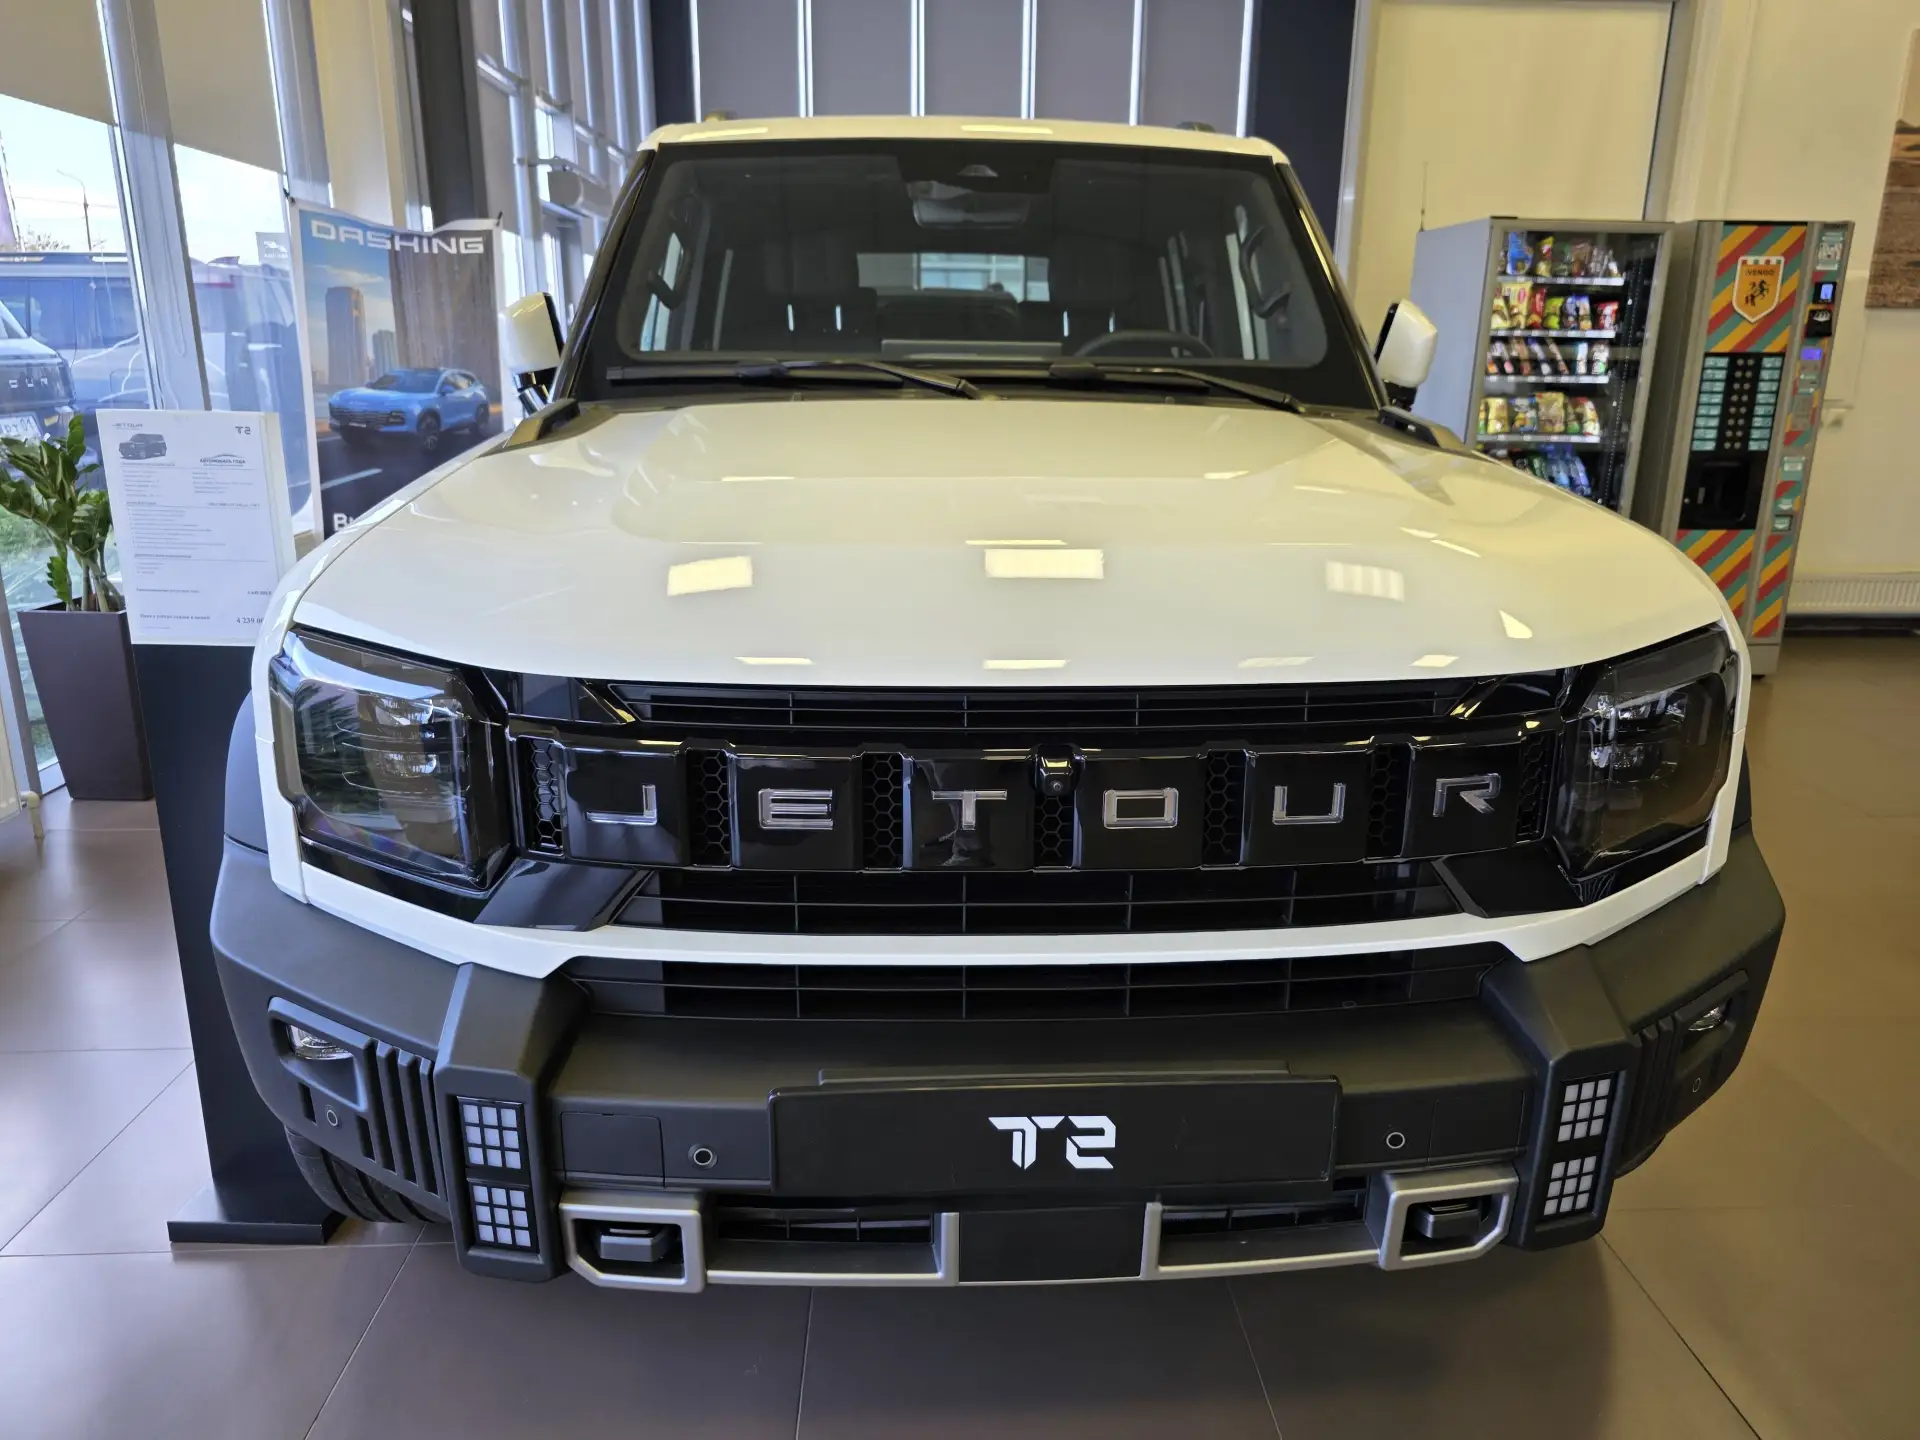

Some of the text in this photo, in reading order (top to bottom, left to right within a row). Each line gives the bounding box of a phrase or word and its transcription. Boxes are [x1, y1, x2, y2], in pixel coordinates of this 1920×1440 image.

[310, 219, 485, 255] DASHING
[586, 772, 1501, 831] JETOUR
[988, 1115, 1117, 1170] T2
